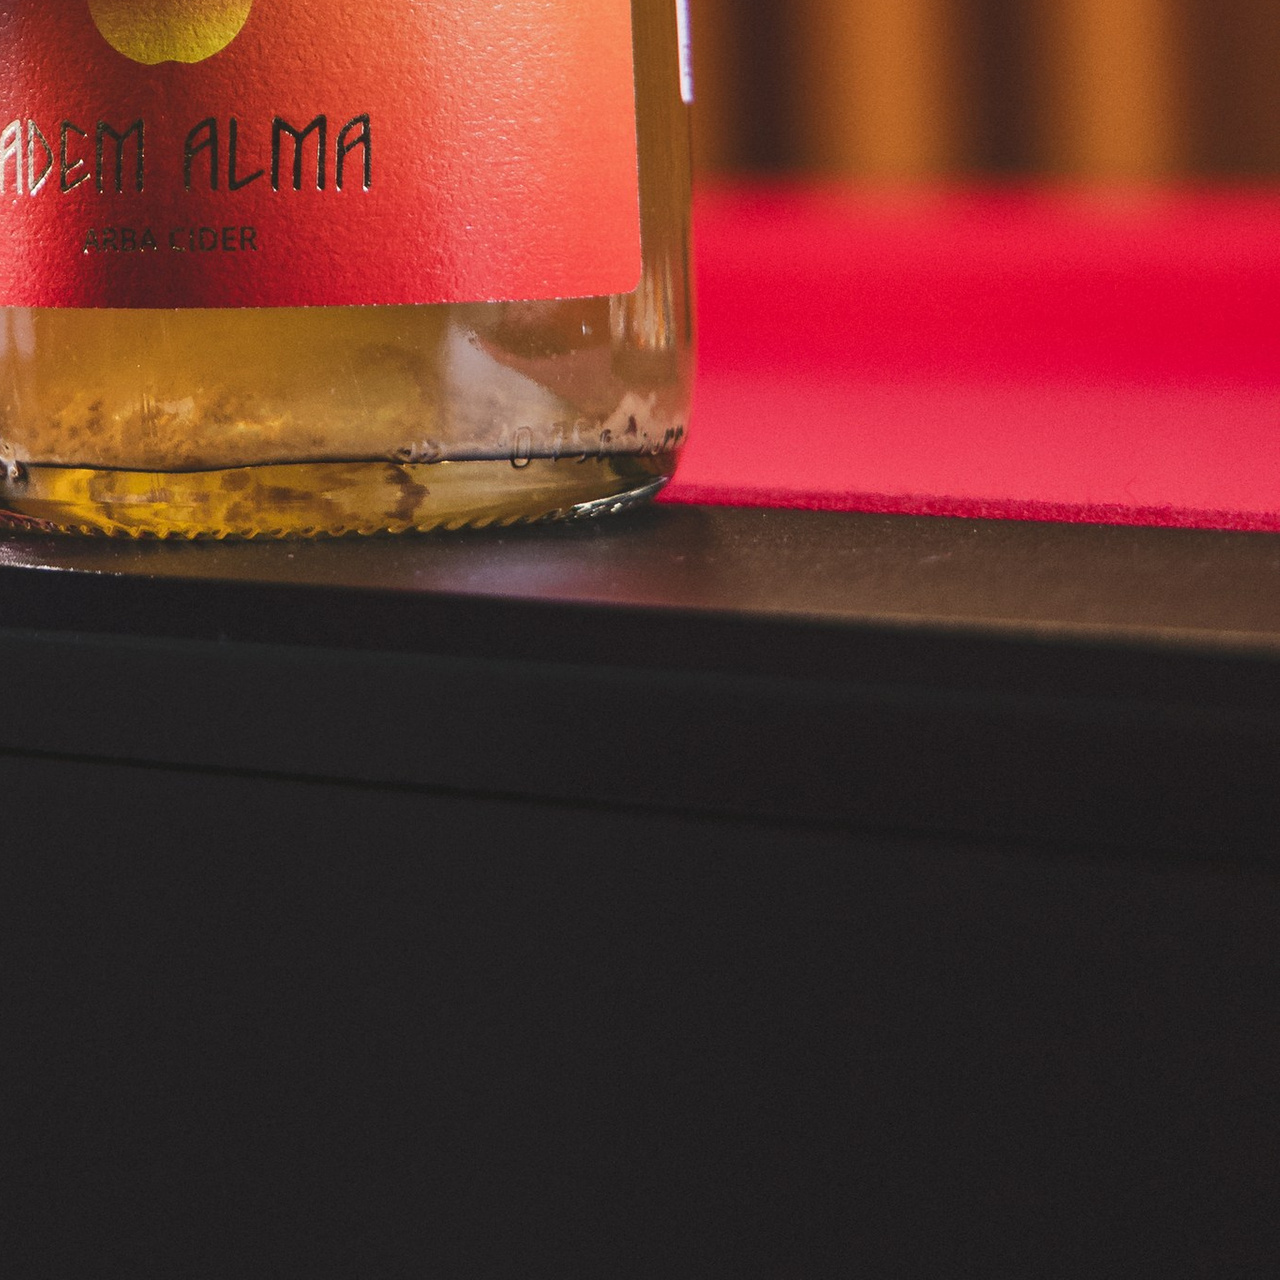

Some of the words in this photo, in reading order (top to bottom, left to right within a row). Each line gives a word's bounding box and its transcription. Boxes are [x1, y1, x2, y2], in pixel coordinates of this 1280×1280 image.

[183, 113, 372, 193] ALMA
[83, 226, 158, 254] ARBA
[170, 226, 258, 252] CIDER
